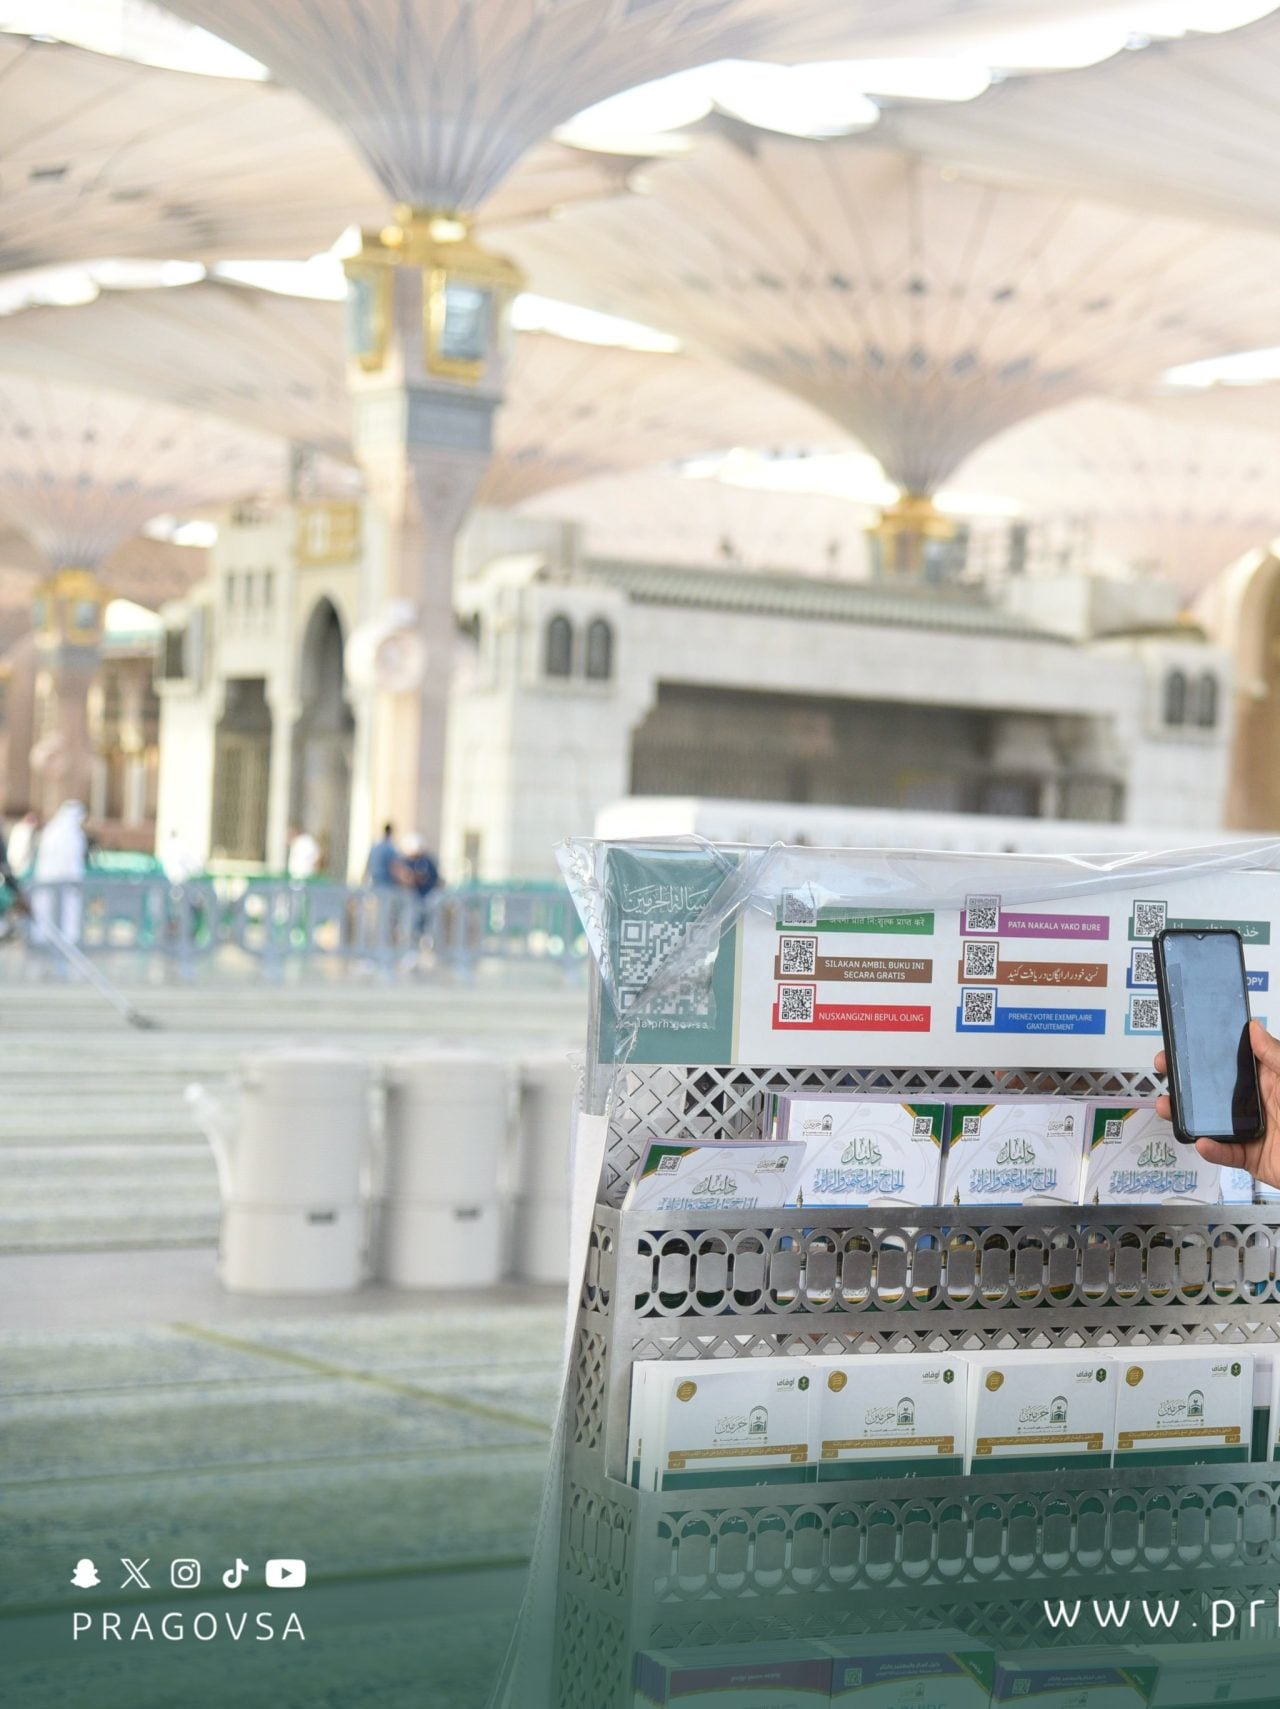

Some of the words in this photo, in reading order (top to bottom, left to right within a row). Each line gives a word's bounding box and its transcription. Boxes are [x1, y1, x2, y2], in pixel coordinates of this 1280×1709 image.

[1008, 921, 1026, 929] PATA
[1028, 922, 1059, 930] NAKALA
[1060, 923, 1080, 931] YAKO
[1081, 923, 1101, 931] BURE
[825, 960, 861, 968] SILAKAN
[862, 961, 887, 969] AMBIL
[888, 961, 911, 969] BUKU
[912, 962, 925, 970] INI
[843, 971, 876, 979] SECARA
[876, 971, 906, 980] GRATIS
[1246, 976, 1264, 986] OPY
[819, 1012, 873, 1021] NUSXANGIZNI
[874, 1013, 898, 1021] BEPUL
[899, 1013, 924, 1022] OLING
[1008, 1012, 1033, 1020] PRENEZ
[1033, 1013, 1054, 1021] VOTRE
[1054, 1014, 1093, 1022] EXEMPLAIRE
[1026, 1023, 1074, 1031] GRATUITEMENT
